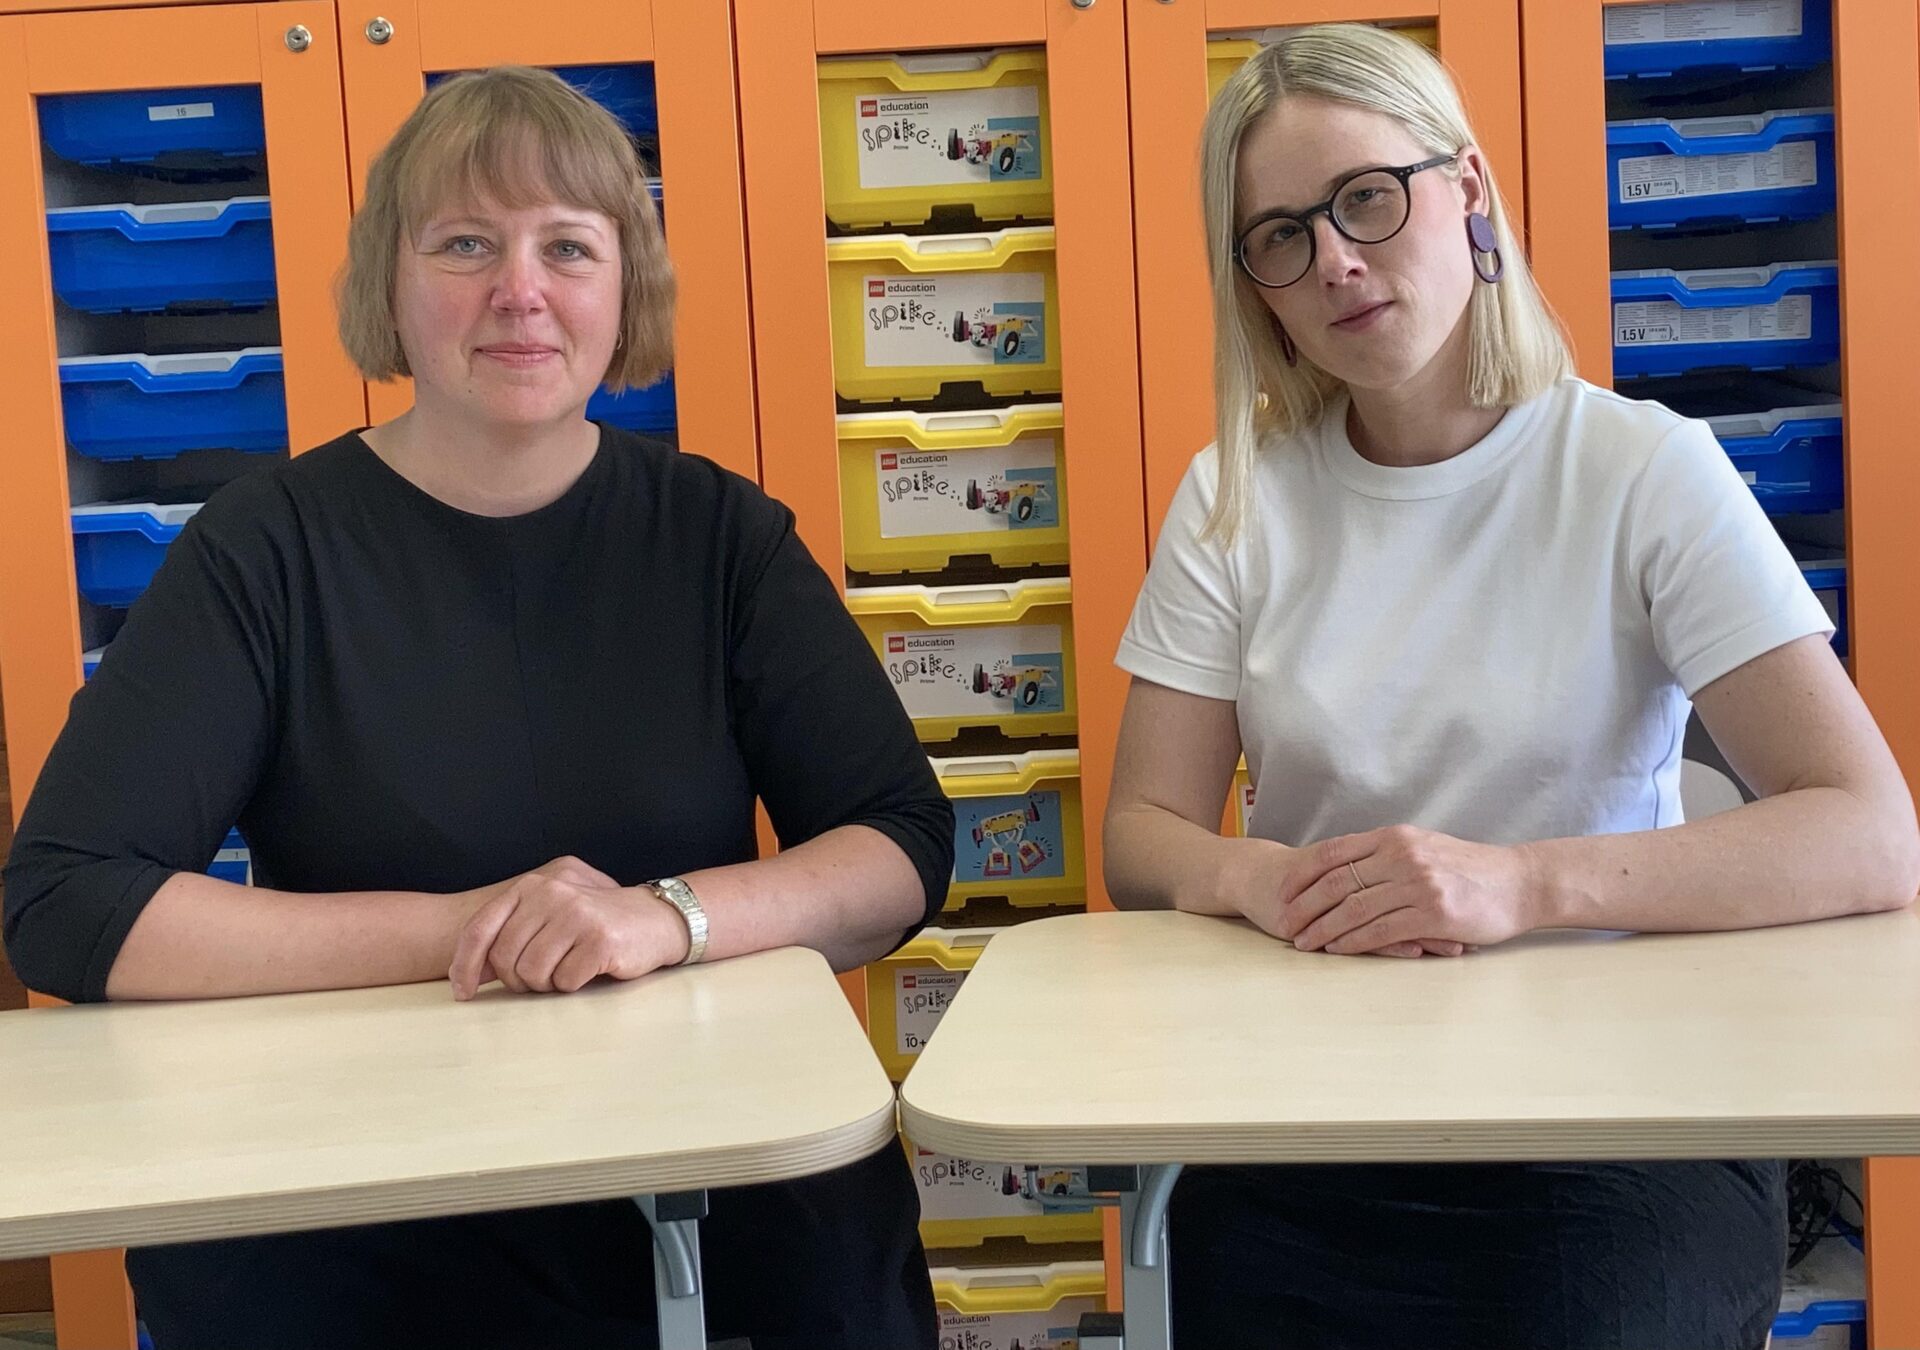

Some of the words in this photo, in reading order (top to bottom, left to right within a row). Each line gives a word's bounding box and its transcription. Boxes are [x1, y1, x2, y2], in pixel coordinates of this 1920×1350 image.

[880, 101, 929, 112] education
[1626, 184, 1642, 197] 1.5
[1643, 183, 1651, 195] V
[887, 283, 936, 292] education
[1621, 328, 1637, 341] 1.5
[1638, 328, 1646, 340] V
[900, 454, 948, 465] education
[907, 638, 955, 648] education
[917, 976, 957, 985] education
[943, 1314, 991, 1325] education
